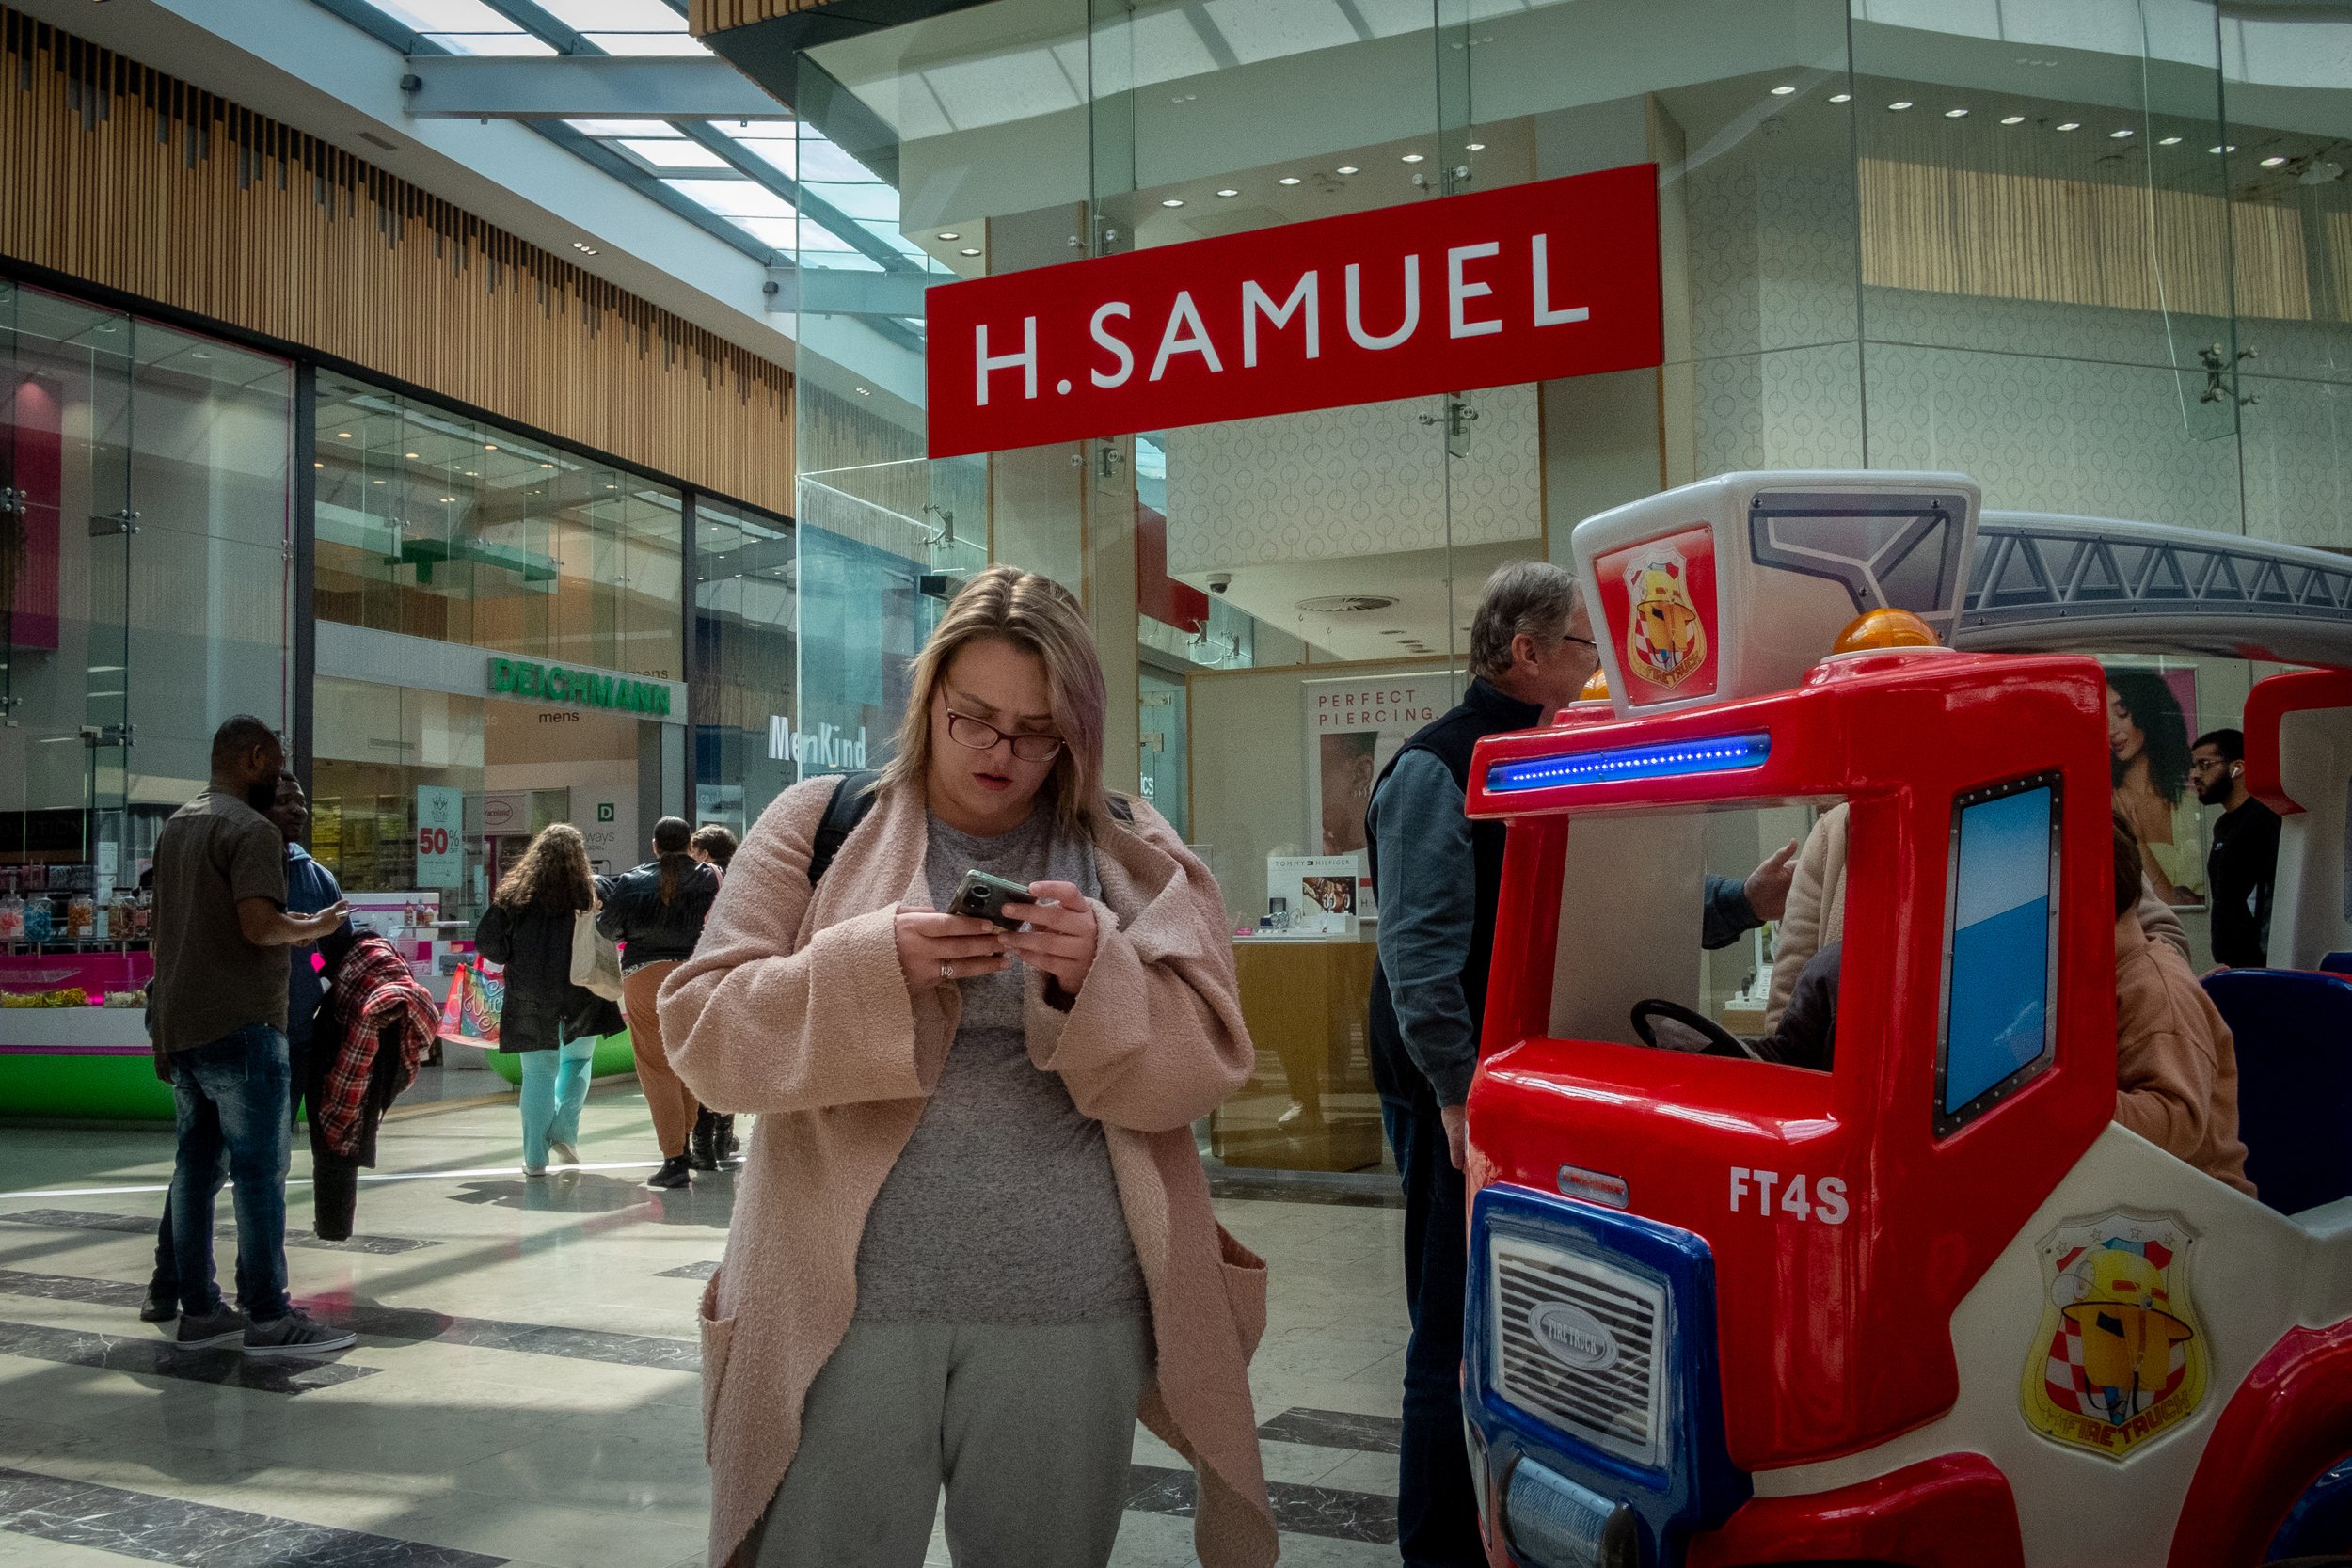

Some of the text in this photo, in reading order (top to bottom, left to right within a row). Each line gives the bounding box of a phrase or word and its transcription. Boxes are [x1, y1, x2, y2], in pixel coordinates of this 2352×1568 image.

[489, 657, 671, 716] DEICHMANN
[1319, 689, 1416, 708] PERFECT
[539, 710, 579, 723] mens
[1319, 707, 1439, 726] PIERCING.
[768, 715, 866, 769] MenKind
[601, 806, 612, 818] D
[1729, 1166, 1850, 1225] FT4S
